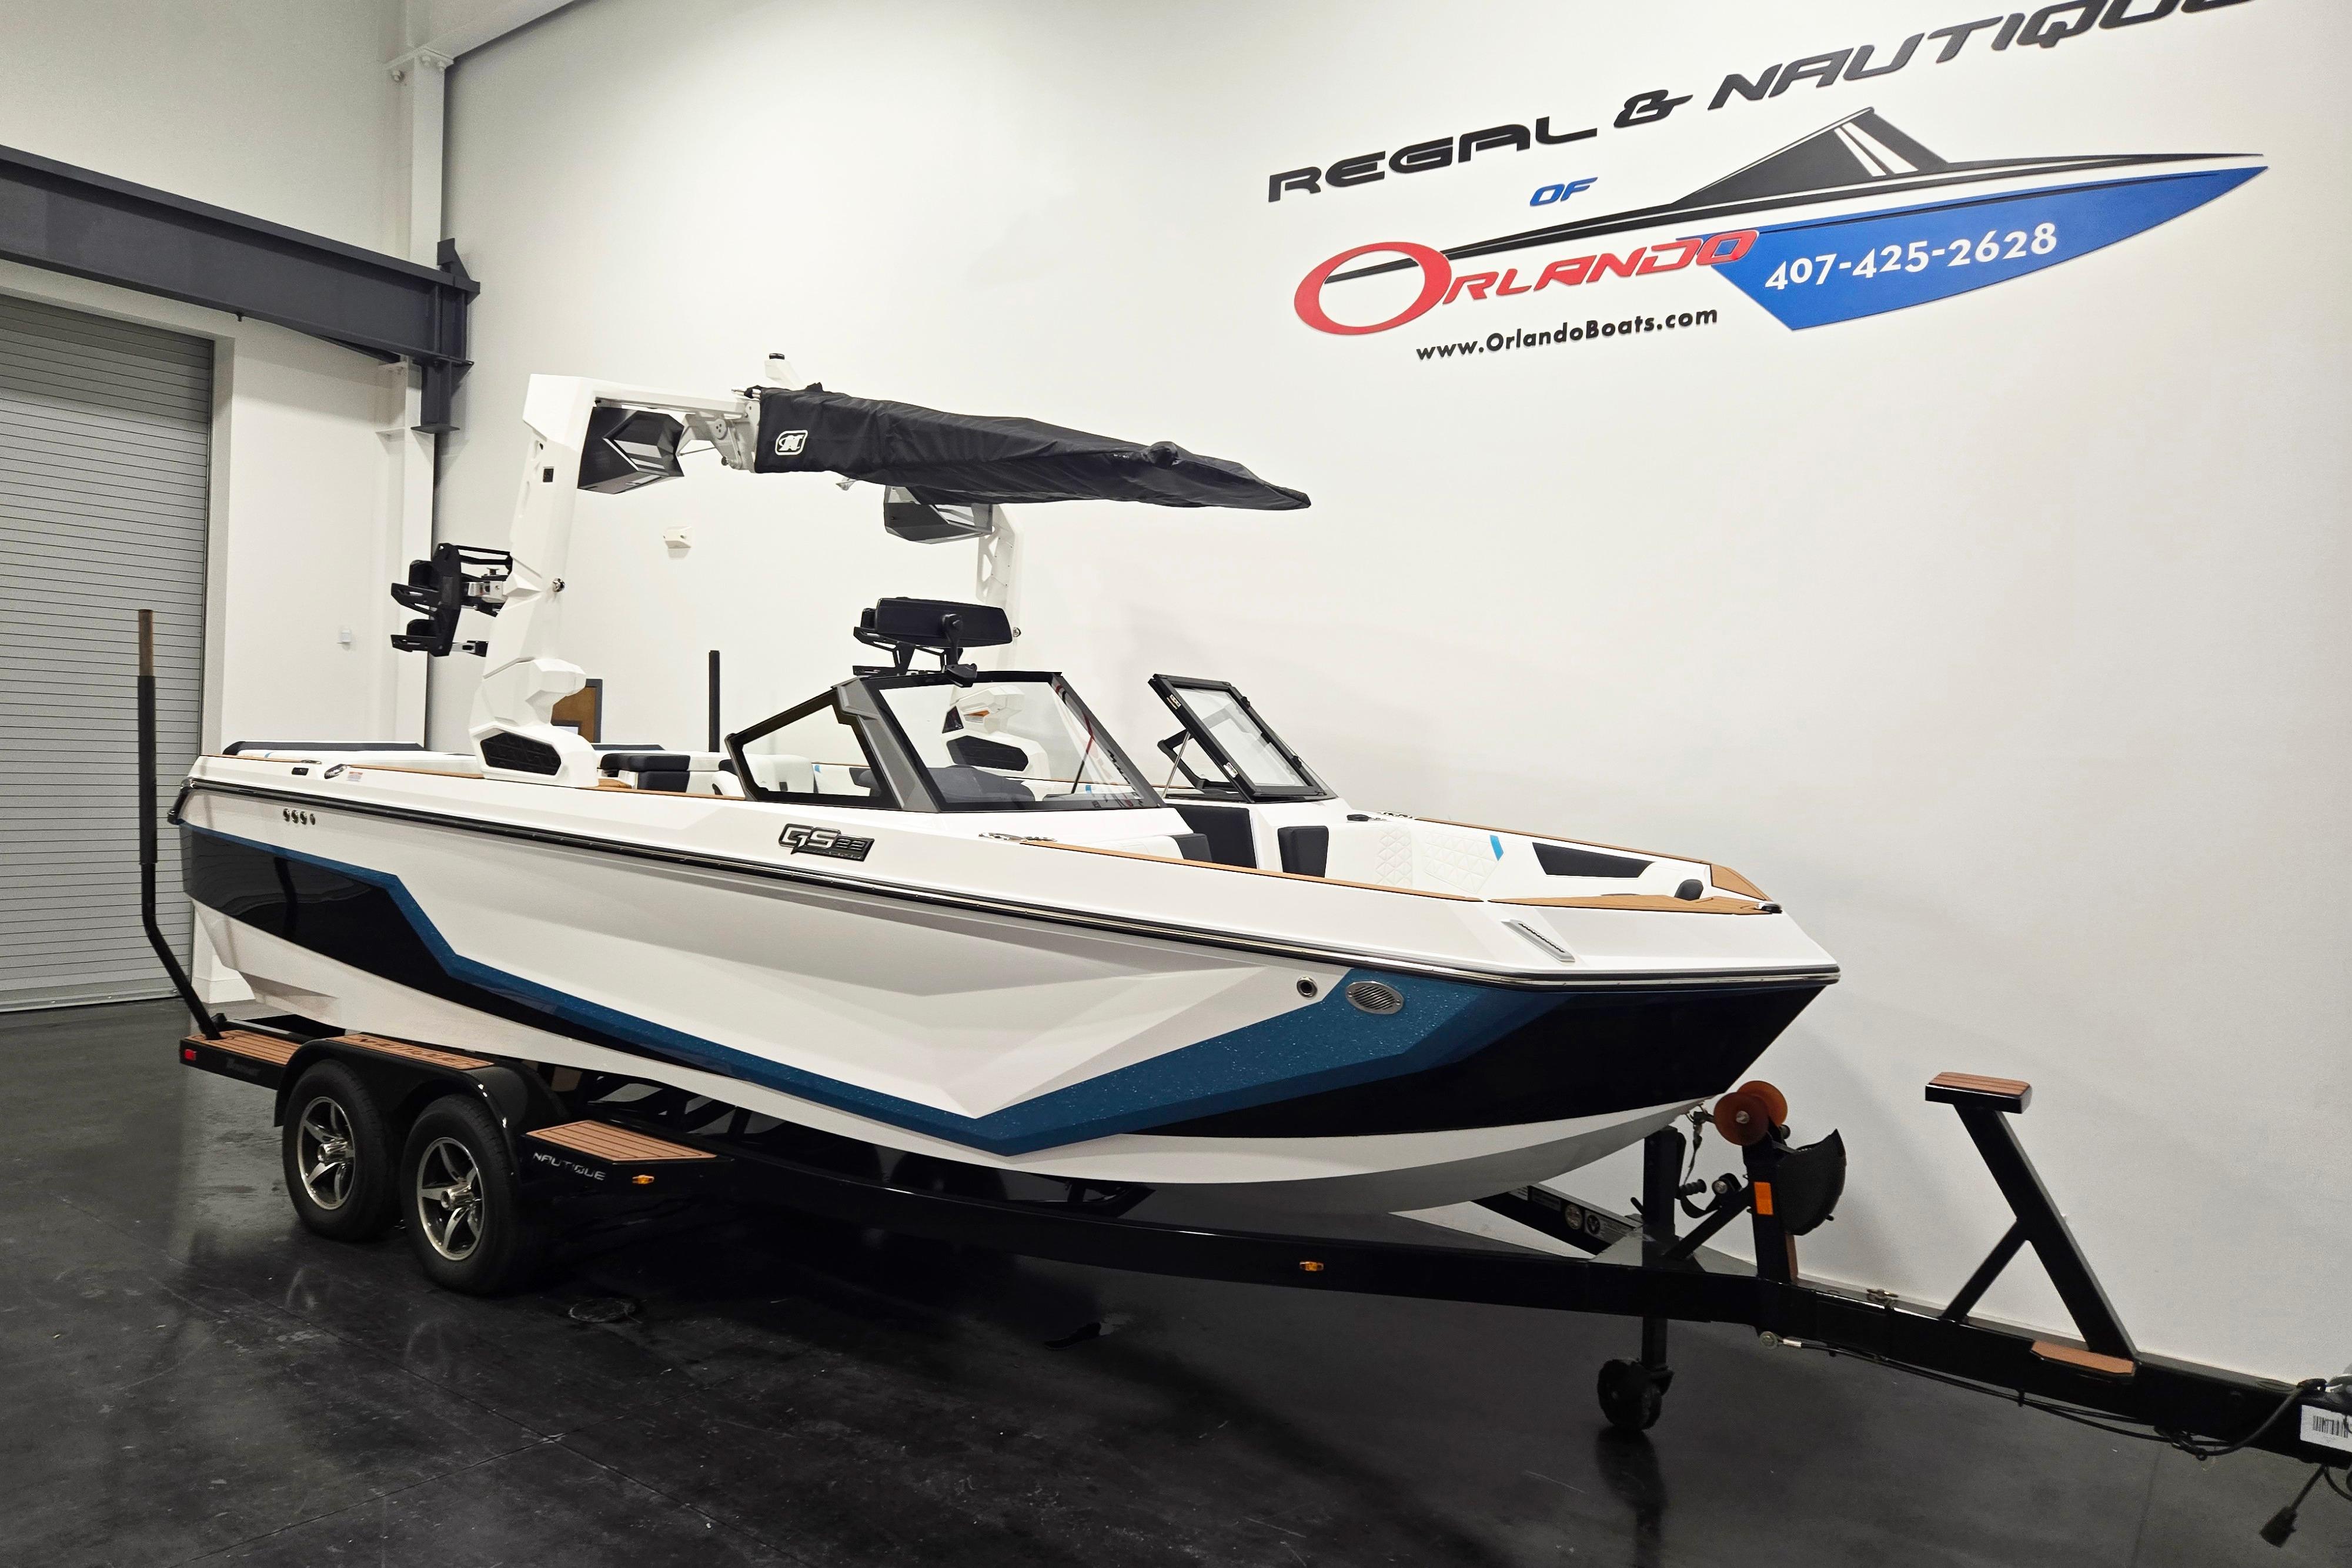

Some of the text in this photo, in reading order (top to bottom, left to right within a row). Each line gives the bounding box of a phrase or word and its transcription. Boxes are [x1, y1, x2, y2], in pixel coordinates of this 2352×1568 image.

[1268, 116, 1598, 203] REGAL
[1613, 89, 1693, 128] &
[1529, 177, 1598, 207] OF
[1294, 230, 1758, 336] ORLANDO
[1765, 222, 2057, 290] 407-425-2628
[1416, 309, 1718, 360] www.OrlandoBoats.com
[532, 1152, 607, 1181] NAUTIQUE
